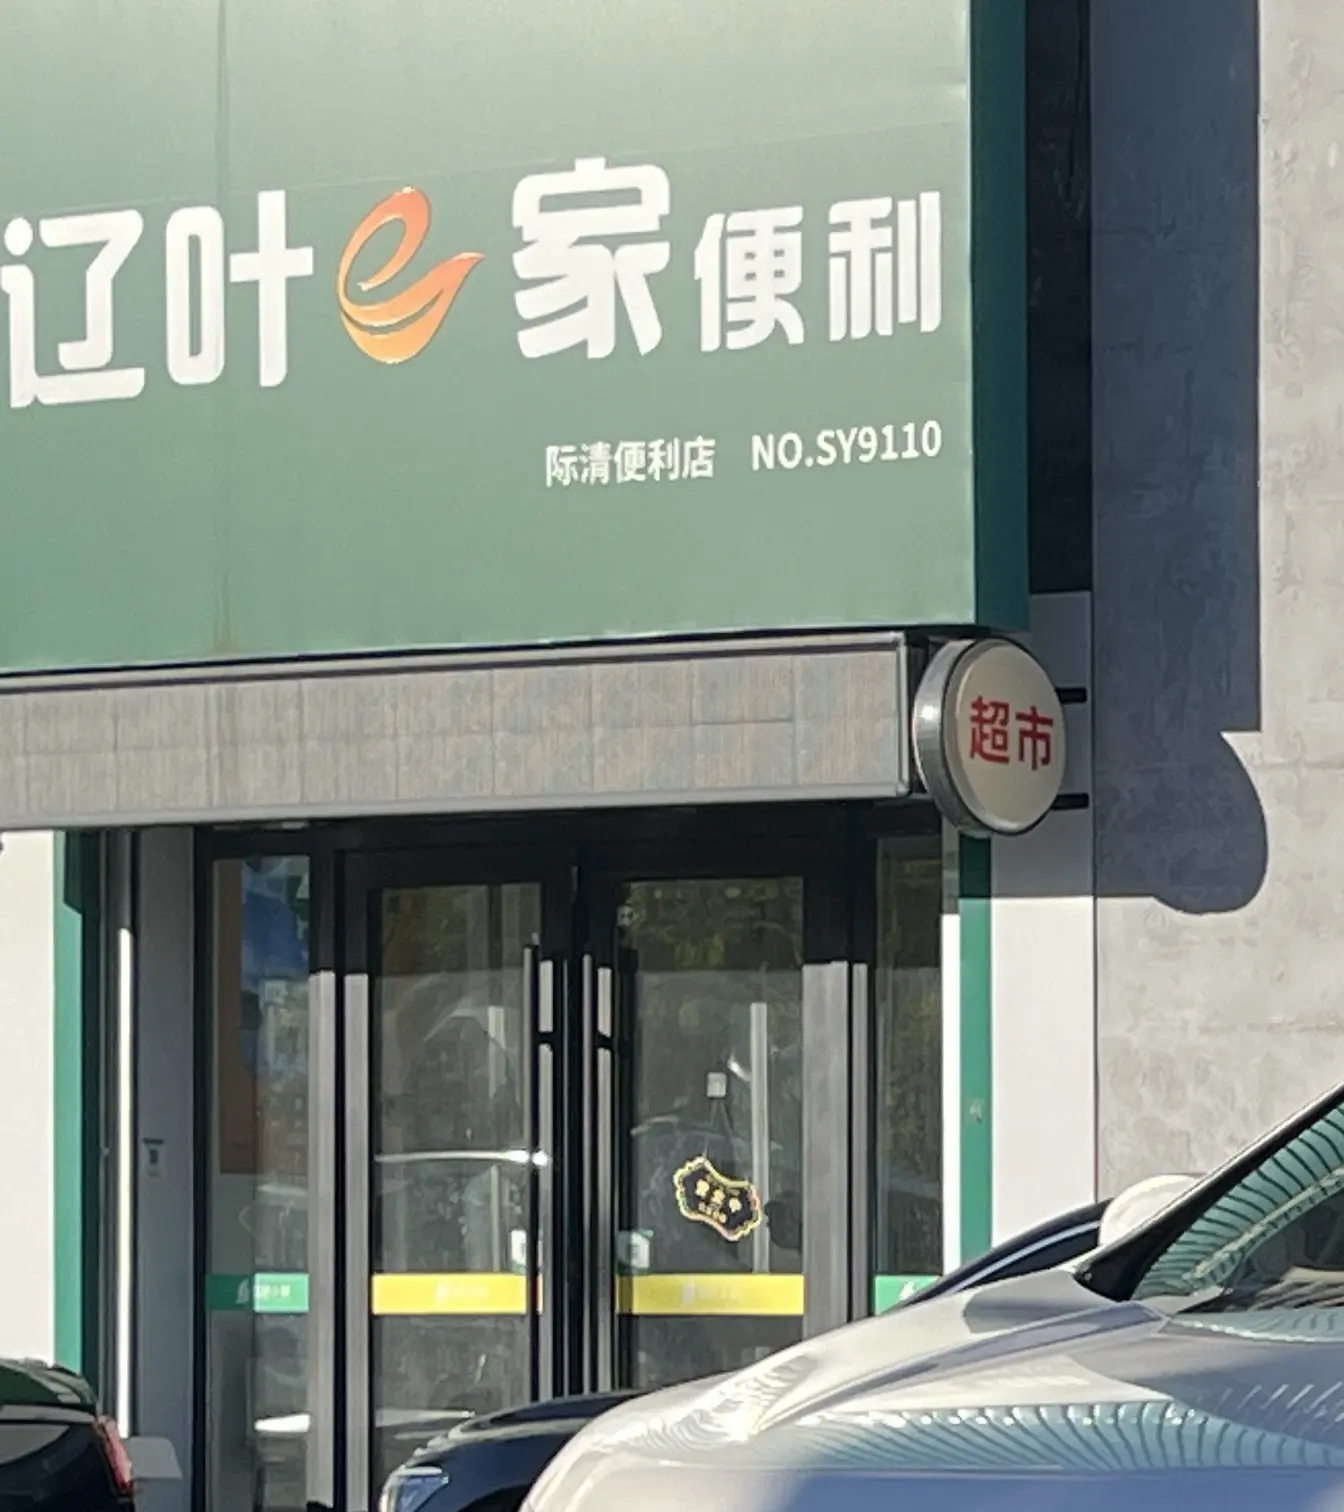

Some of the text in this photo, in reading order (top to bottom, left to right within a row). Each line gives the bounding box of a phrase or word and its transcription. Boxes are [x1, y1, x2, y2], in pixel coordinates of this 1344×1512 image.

[546, 421, 943, 487] 际清便利店 NO.SY9110
[968, 694, 1055, 773] 超市
